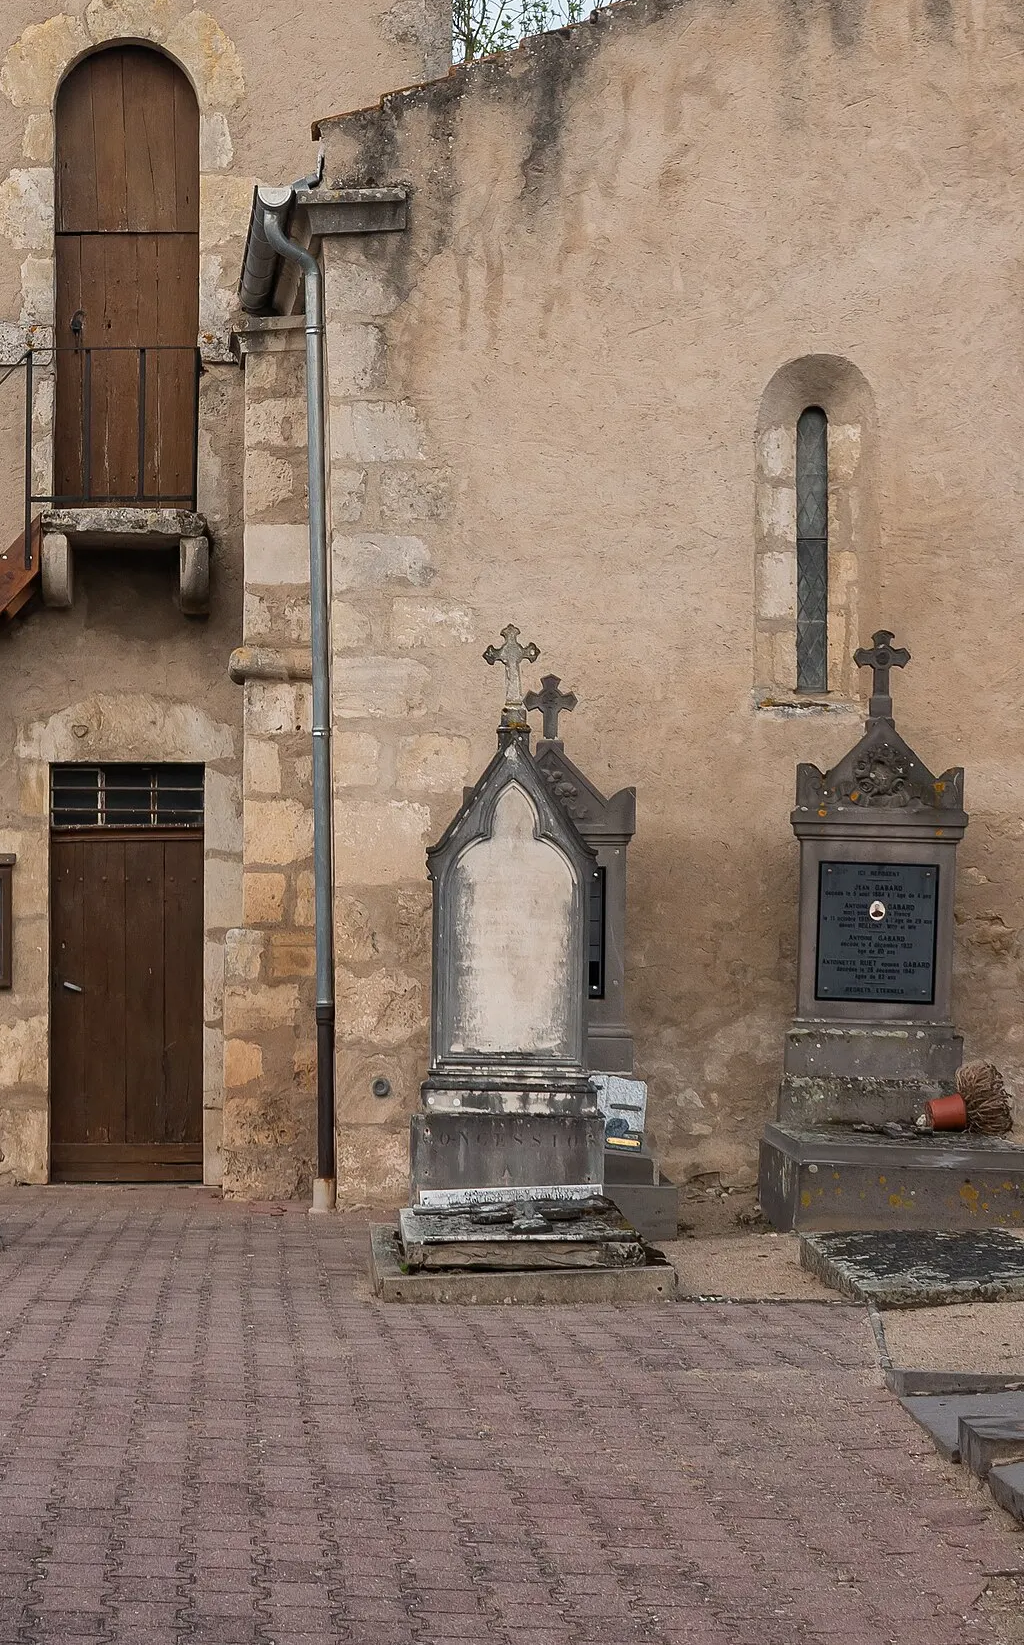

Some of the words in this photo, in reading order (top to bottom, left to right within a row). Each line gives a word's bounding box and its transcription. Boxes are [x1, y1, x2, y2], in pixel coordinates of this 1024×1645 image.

[874, 884, 903, 892] GABARD
[887, 903, 916, 911] GABARD
[877, 934, 906, 942] GABARD
[902, 961, 931, 969] GABARD
